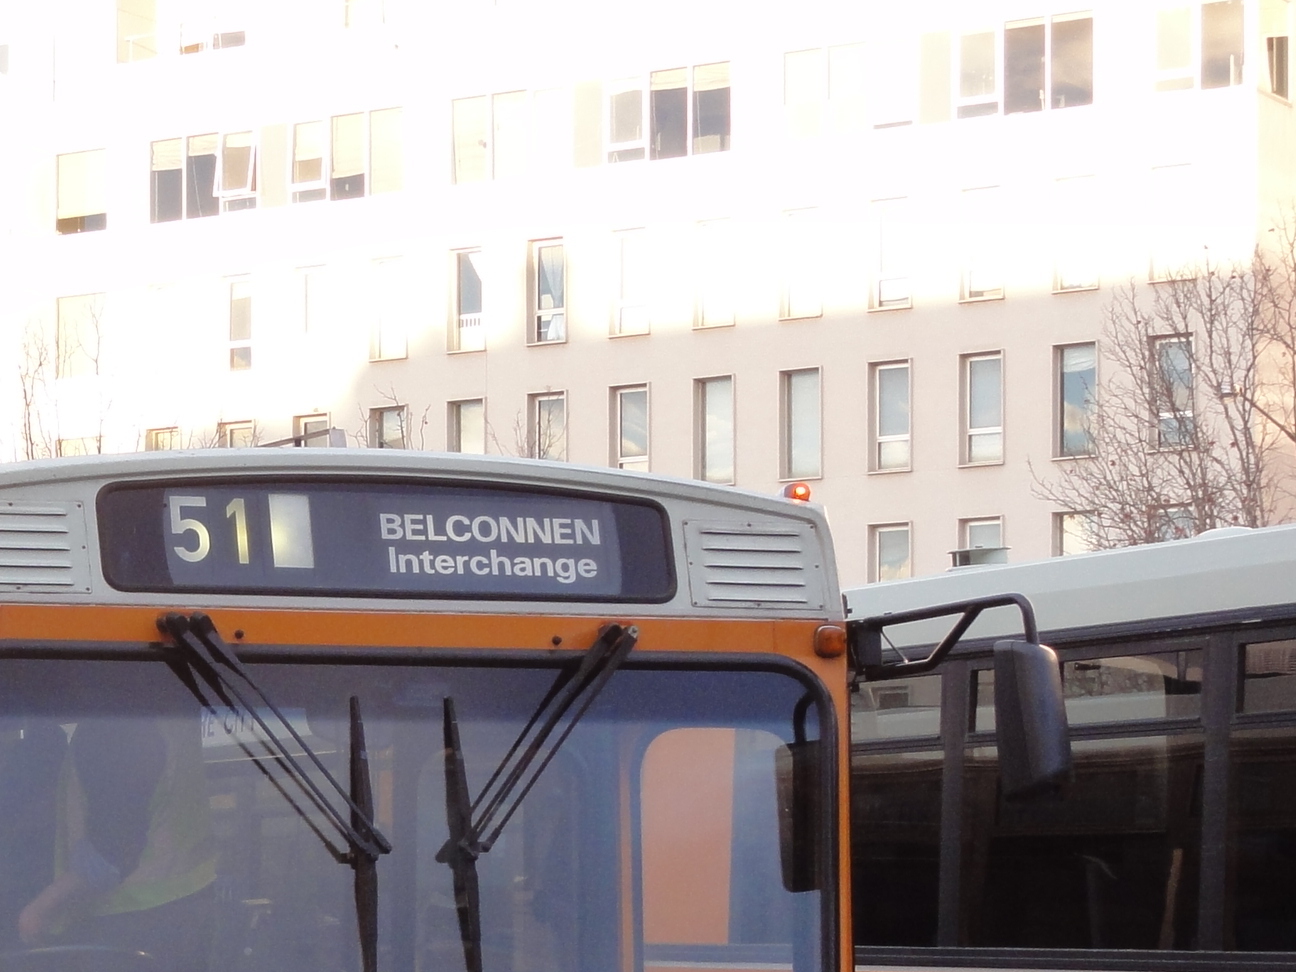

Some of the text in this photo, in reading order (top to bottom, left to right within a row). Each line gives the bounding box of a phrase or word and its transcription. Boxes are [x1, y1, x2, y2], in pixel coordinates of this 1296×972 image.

[169, 496, 249, 564] 51
[380, 512, 601, 545] BELCONNEN
[389, 548, 598, 583] Interchange
